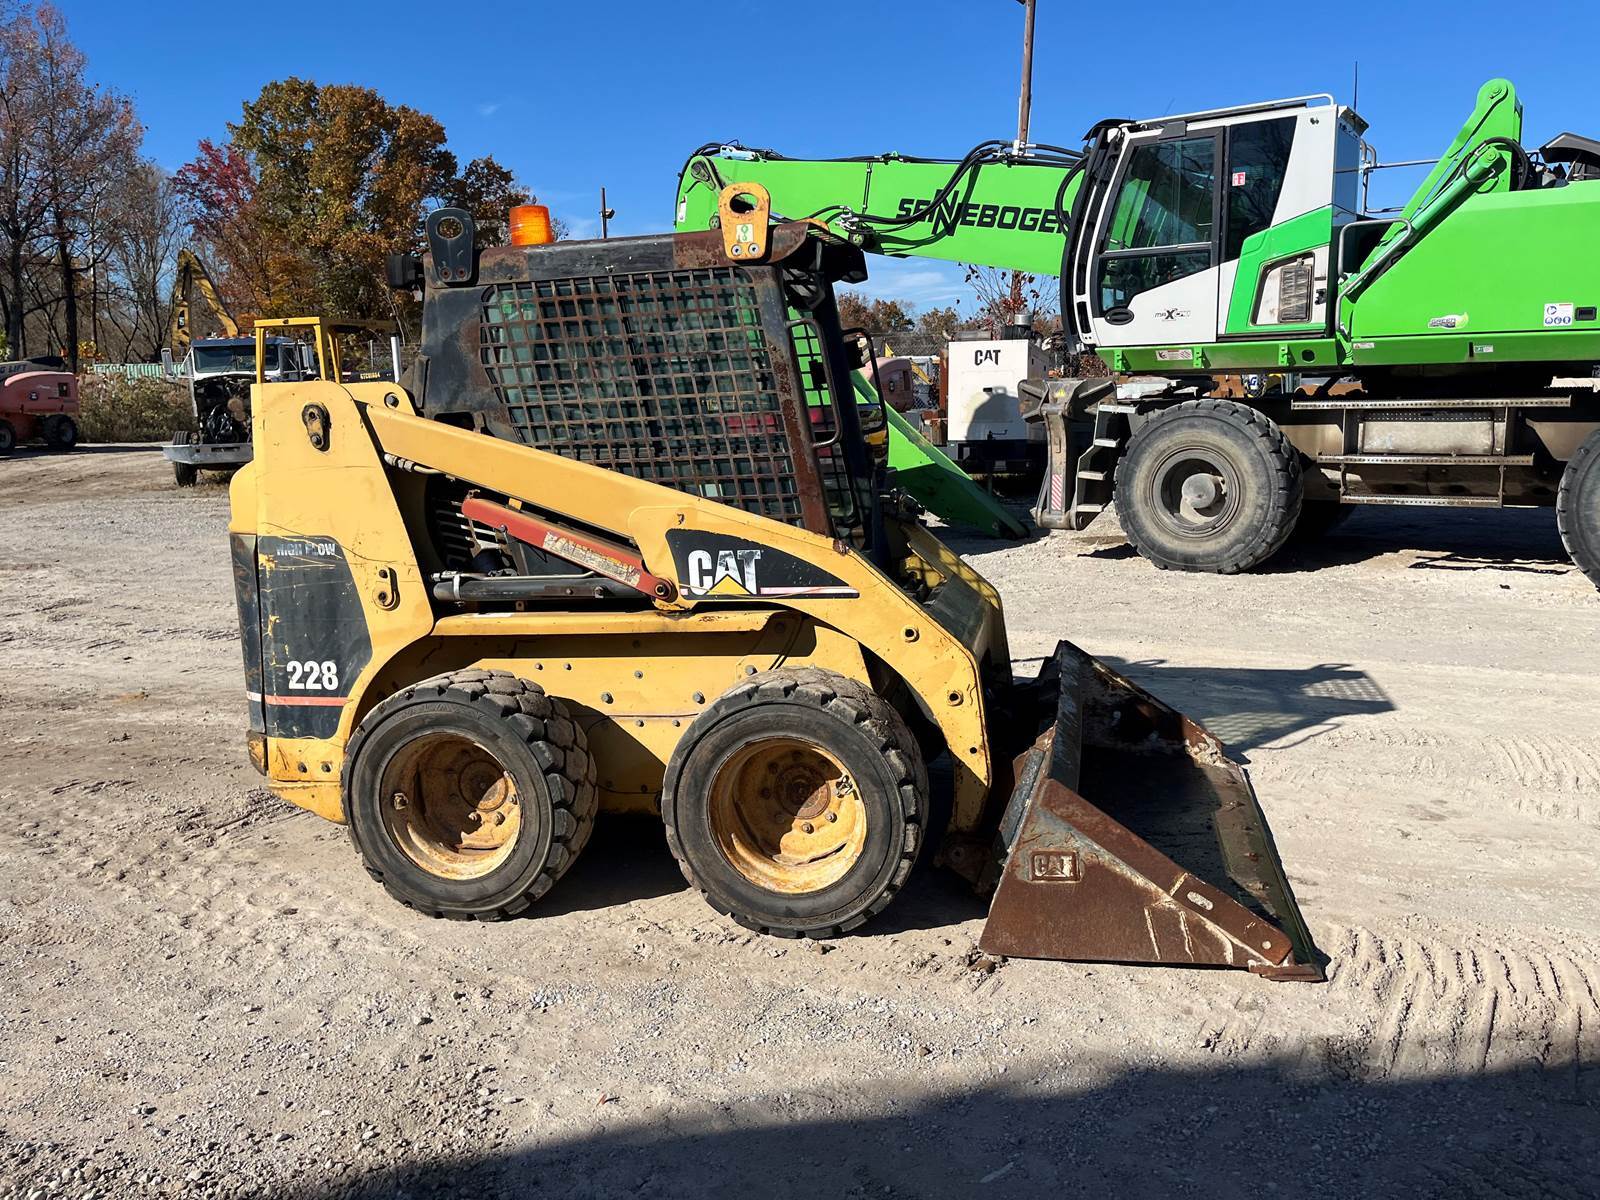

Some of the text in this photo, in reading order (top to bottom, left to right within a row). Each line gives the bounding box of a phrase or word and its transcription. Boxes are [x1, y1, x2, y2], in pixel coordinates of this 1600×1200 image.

[896, 188, 1071, 237] SENNEBOGE
[974, 349, 1001, 366] CAT
[276, 543, 335, 556] HIGH FLOW
[688, 549, 761, 596] CAT
[286, 660, 339, 691] 228
[1034, 854, 1073, 877] CAT
